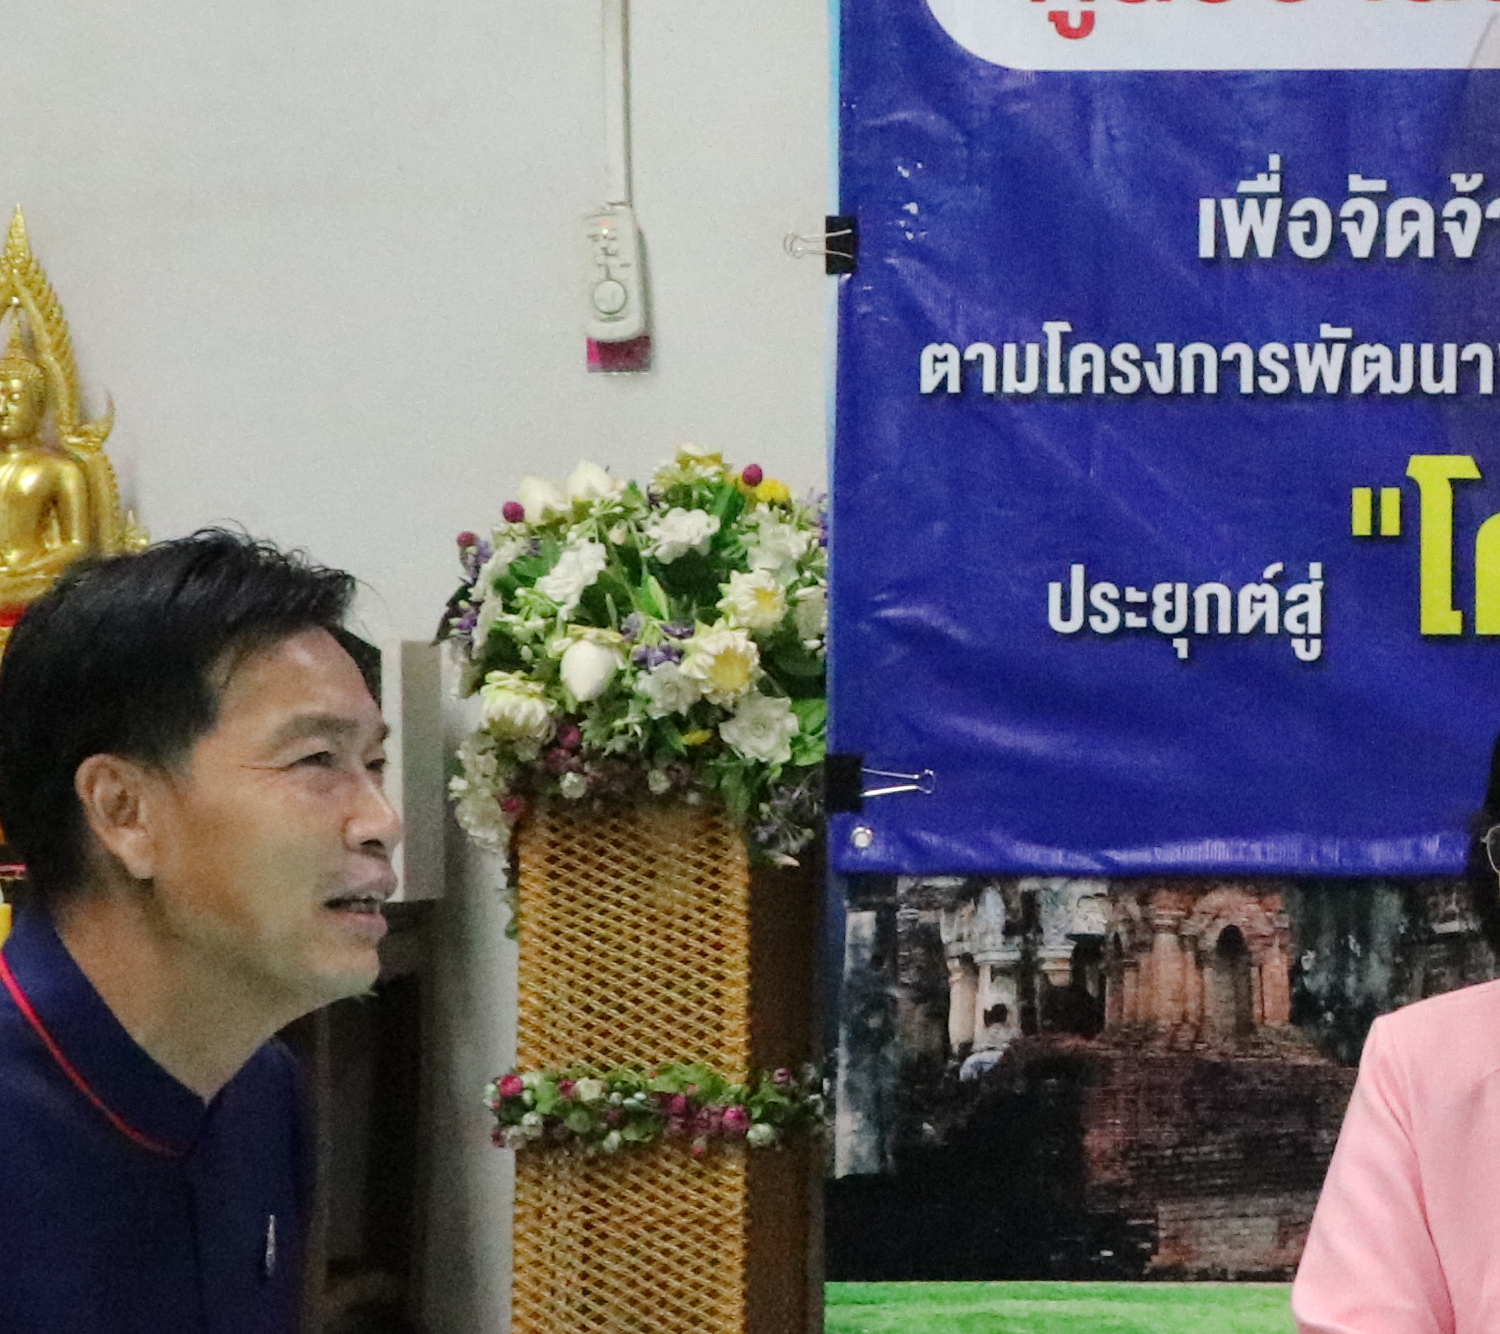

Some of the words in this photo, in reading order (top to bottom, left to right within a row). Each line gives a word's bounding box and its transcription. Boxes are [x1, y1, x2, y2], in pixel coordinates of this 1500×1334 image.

[1047, 561, 1325, 662] ประยุกต์สู่
